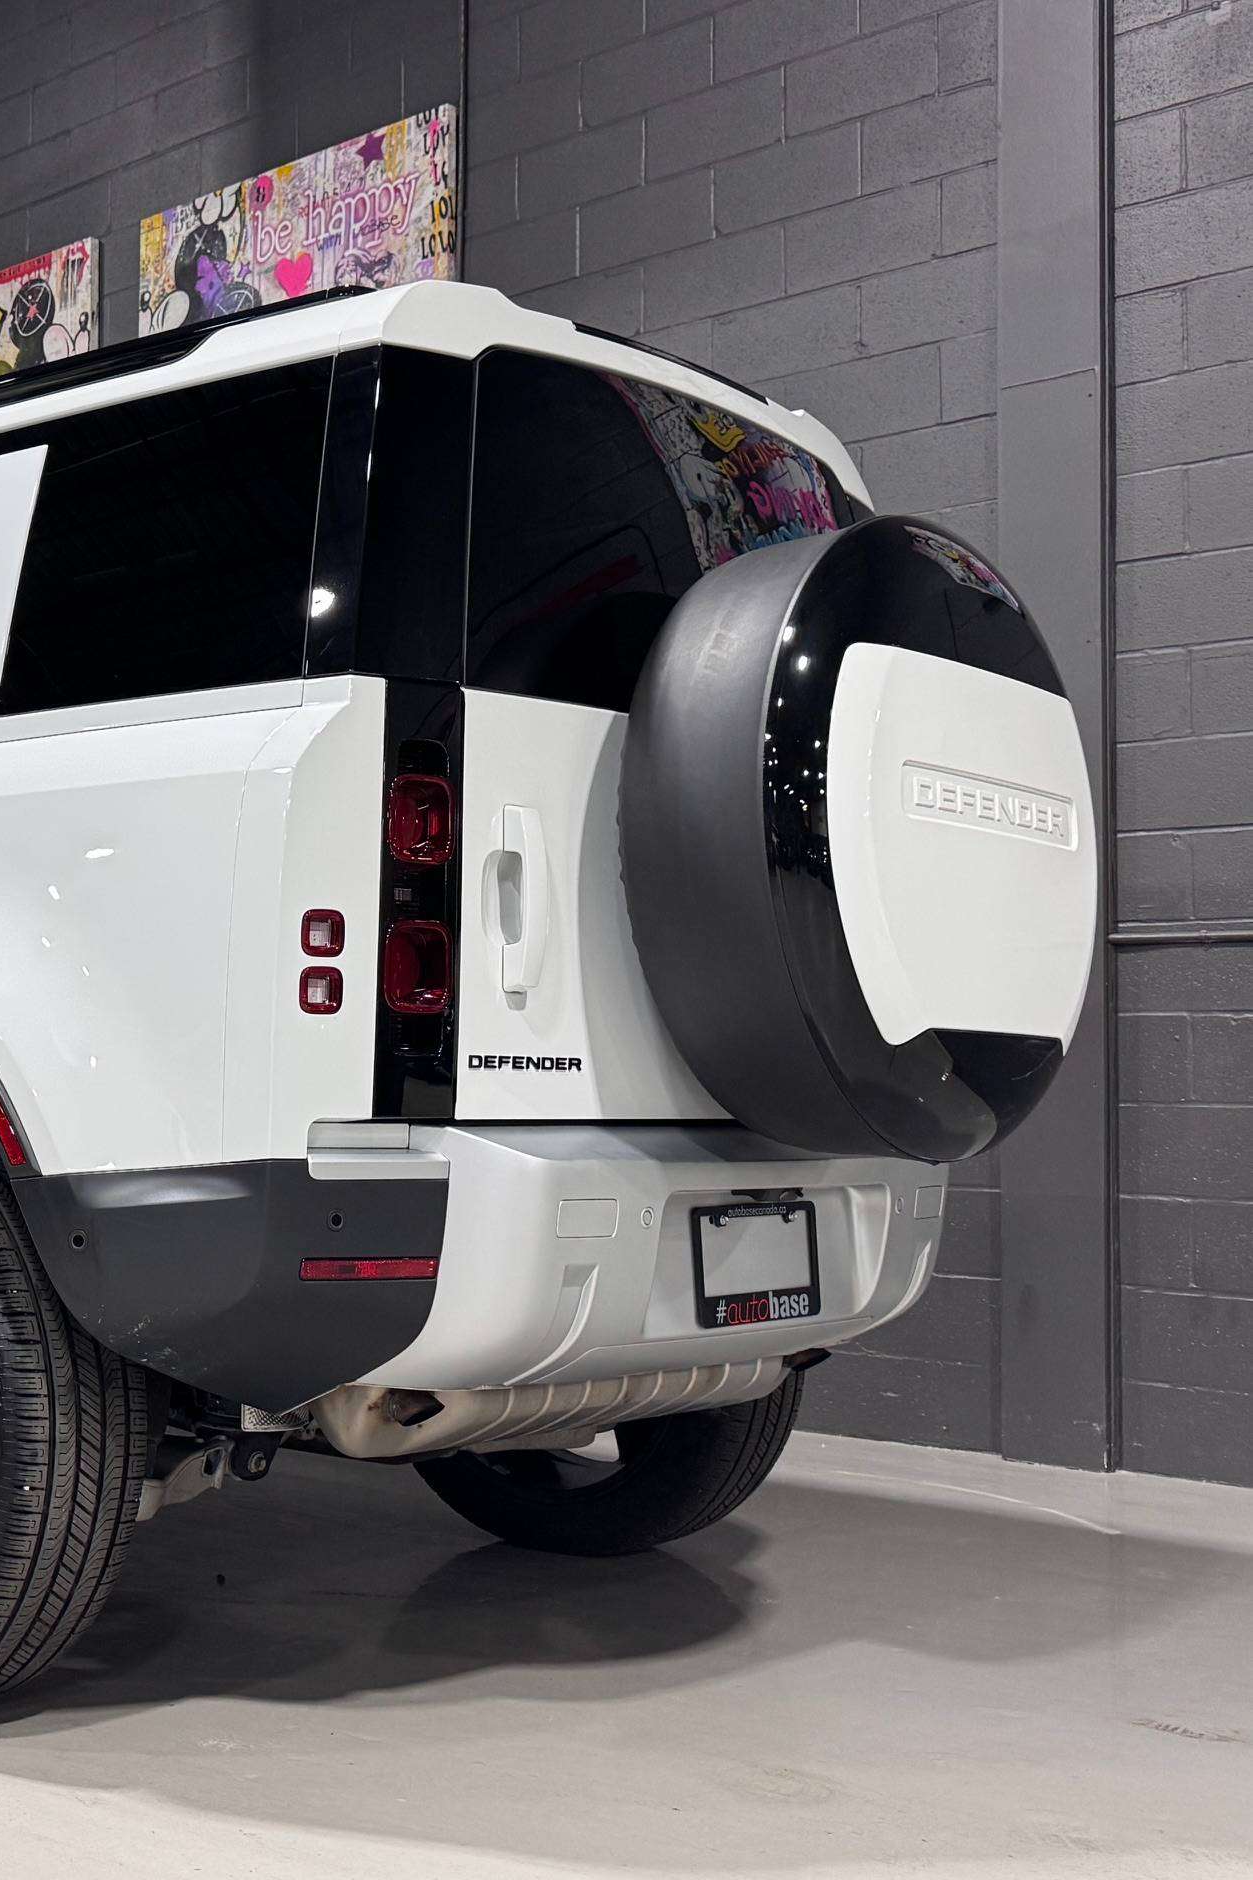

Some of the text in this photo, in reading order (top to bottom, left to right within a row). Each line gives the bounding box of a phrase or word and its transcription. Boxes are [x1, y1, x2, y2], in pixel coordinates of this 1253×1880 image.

[254, 209, 292, 263] be
[302, 171, 421, 253] happy
[913, 776, 1064, 838] DEFENDER
[468, 1054, 583, 1072] DEFENDER
[716, 1290, 810, 1325] #autobase
